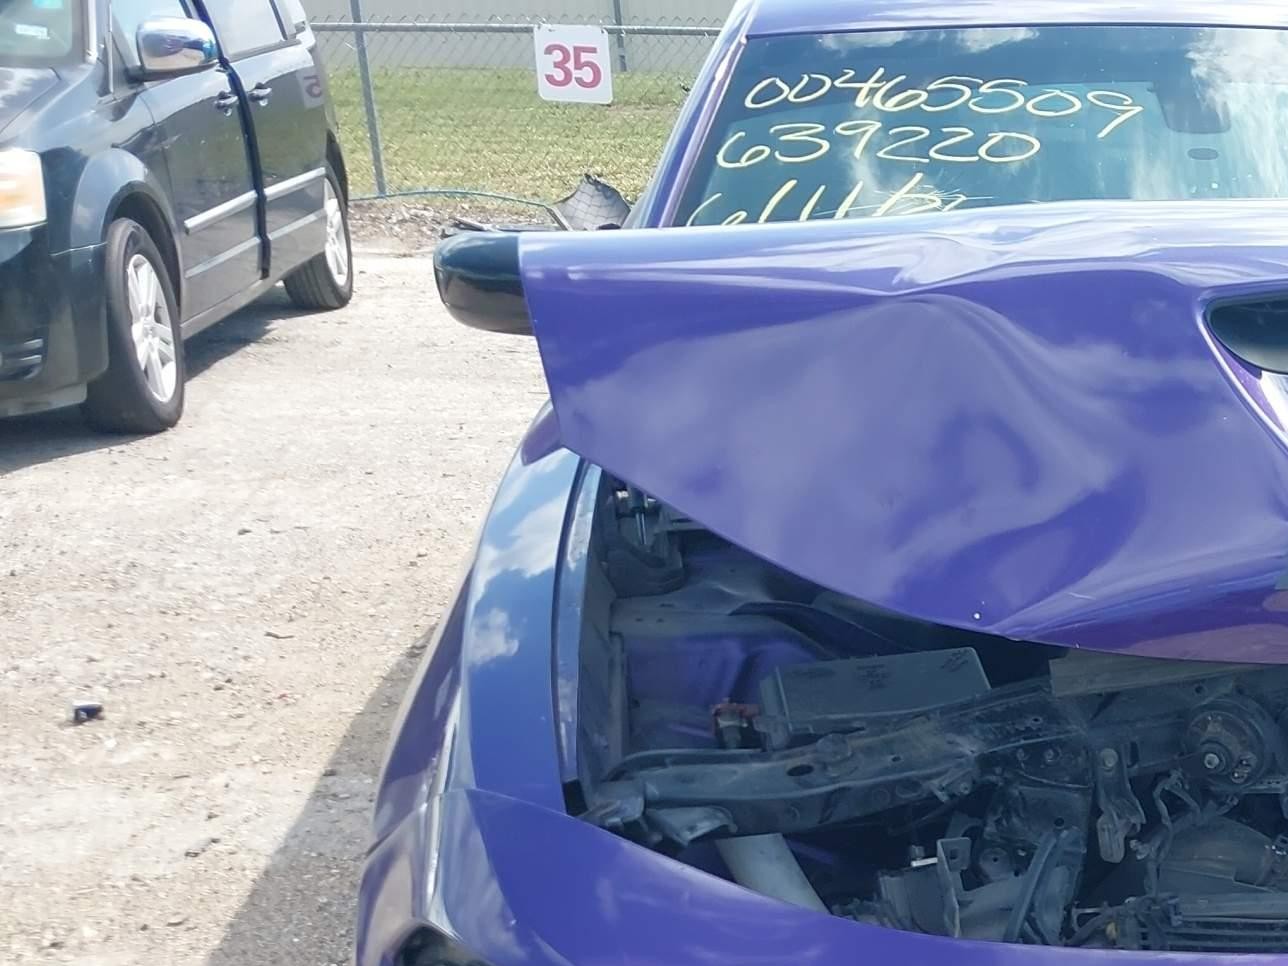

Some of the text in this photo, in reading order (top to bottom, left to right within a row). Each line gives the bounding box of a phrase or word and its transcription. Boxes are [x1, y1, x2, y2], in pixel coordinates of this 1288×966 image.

[543, 43, 602, 89] 35
[744, 67, 1144, 138] 00465509
[716, 120, 1041, 168] 639220
